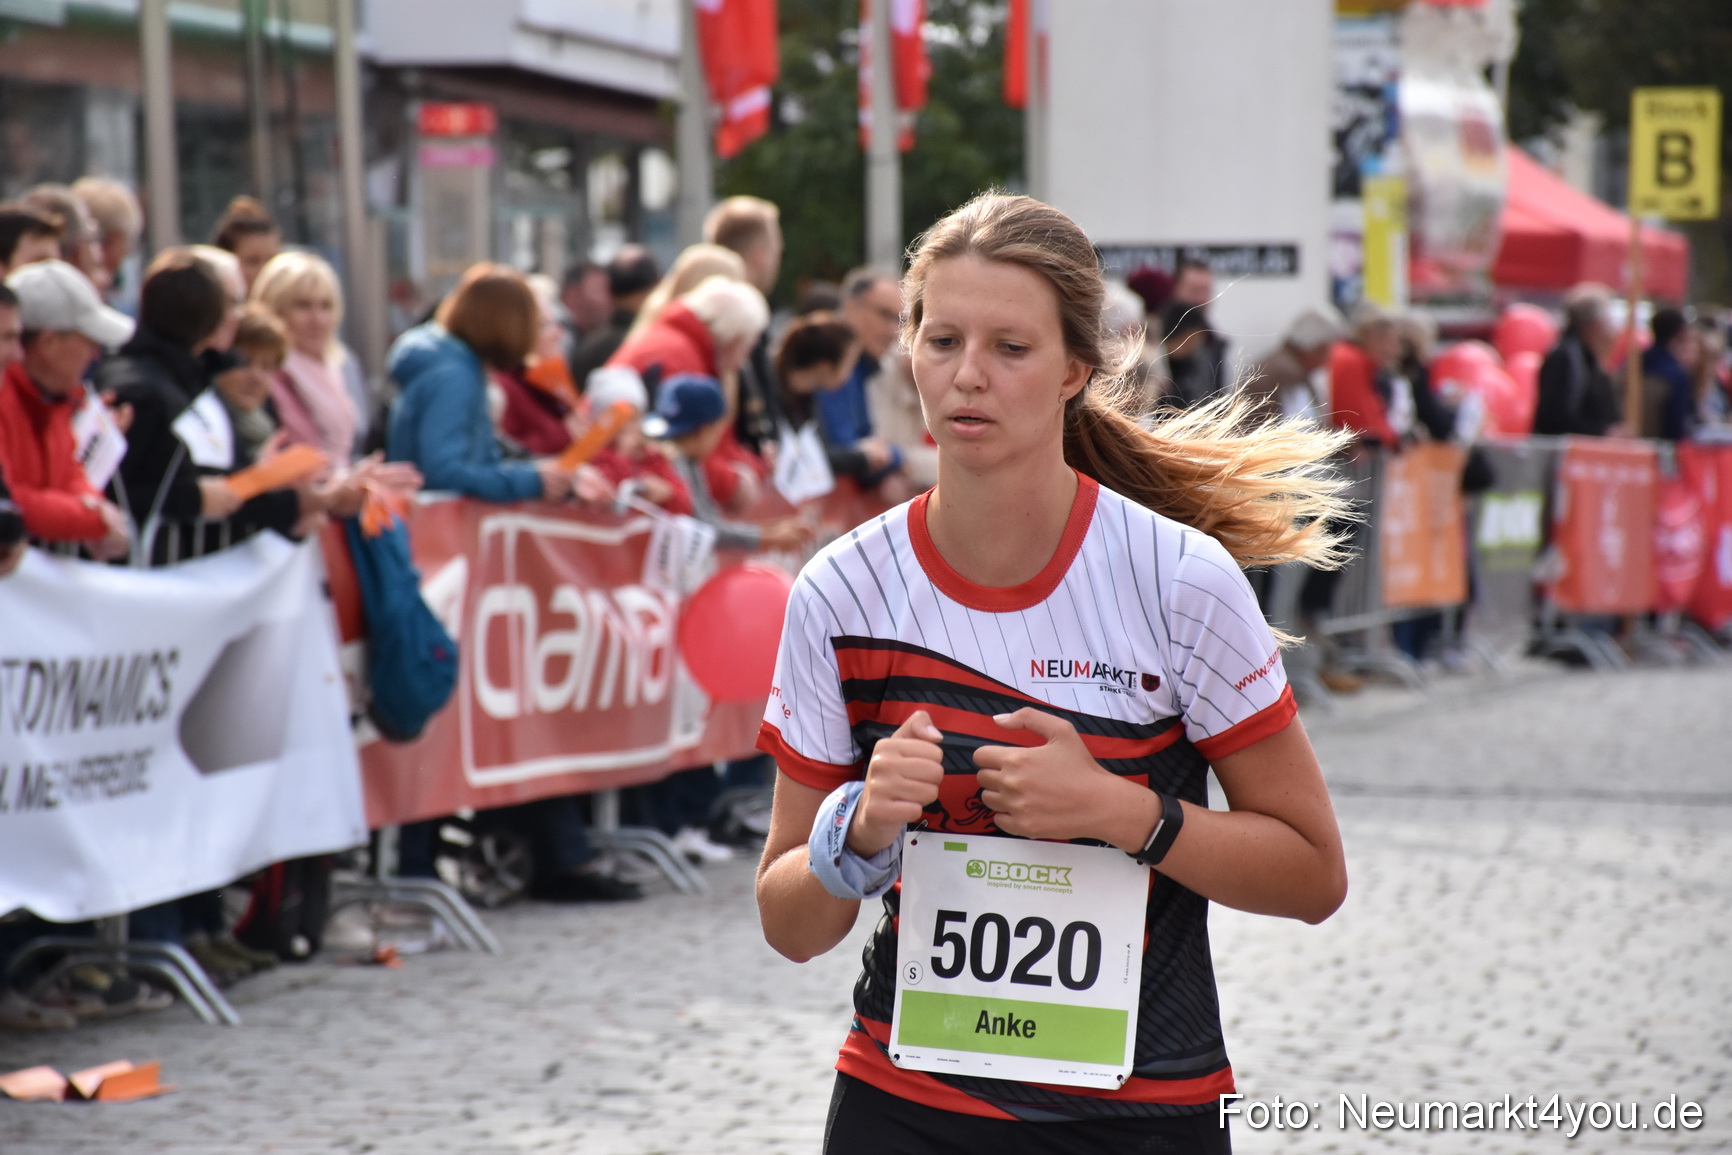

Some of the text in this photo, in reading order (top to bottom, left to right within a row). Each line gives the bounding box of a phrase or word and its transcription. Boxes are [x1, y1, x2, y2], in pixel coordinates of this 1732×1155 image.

[1656, 131, 1694, 187] B
[1031, 659, 1137, 689] NEUMARKT
[987, 880, 1012, 889] inspired
[1023, 884, 1042, 892] smart
[1043, 886, 1073, 895] concepts
[988, 861, 1073, 886] BOCK
[931, 909, 1102, 991] 5020
[909, 967, 917, 980] S
[974, 1009, 1037, 1039] Anke
